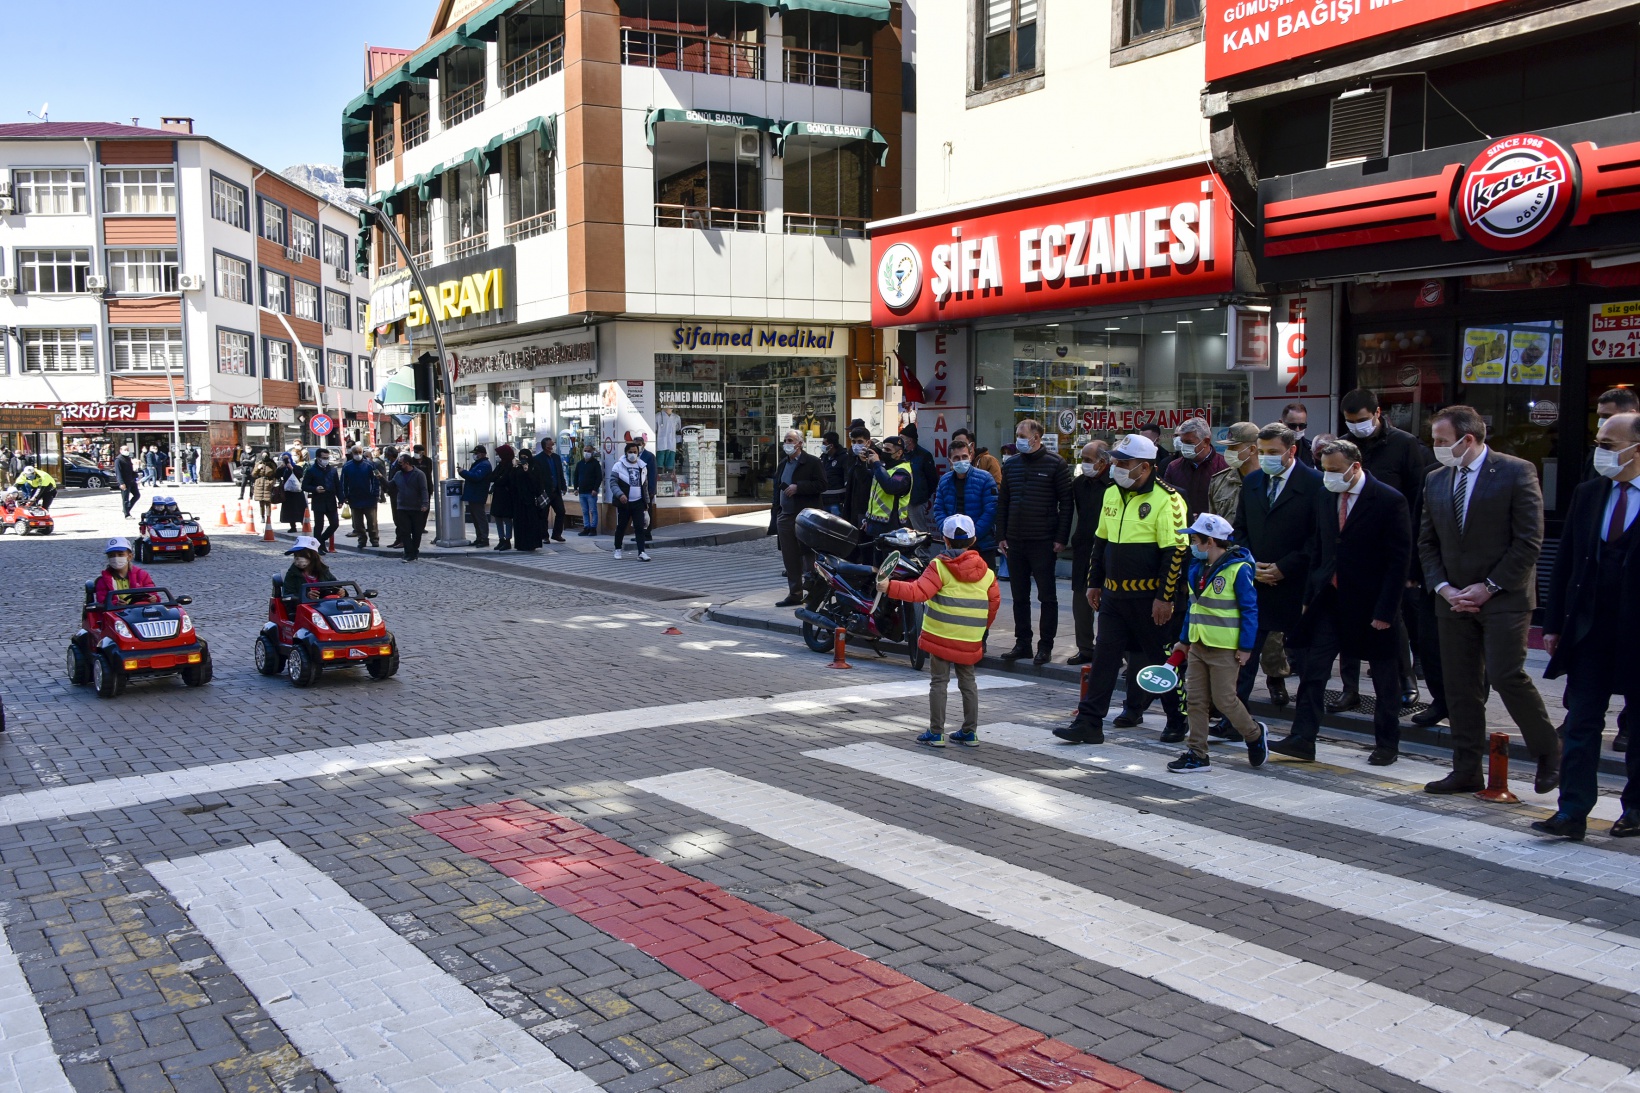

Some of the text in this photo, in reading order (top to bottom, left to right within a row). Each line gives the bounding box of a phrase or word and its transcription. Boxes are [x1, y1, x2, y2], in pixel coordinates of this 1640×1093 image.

[1223, 0, 1362, 54] KAN BAĞIŞI
[686, 110, 744, 126] GÖNÜL SARAYI
[806, 123, 862, 137] GÖNÜL SARAYI
[1487, 137, 1544, 158] SINCE 1988
[931, 180, 1217, 303] ŞİFA ECZANESİ
[406, 267, 504, 328] SARAYI
[1607, 304, 1621, 314] siz
[1594, 317, 1616, 329] biz
[673, 326, 835, 351] Şifamed Medikal
[1613, 341, 1640, 358] 21
[658, 391, 724, 403] ŞİFAMED MEDİKAL
[1082, 406, 1118, 434] ŞİFA
[1140, 670, 1172, 688] GEÇ
